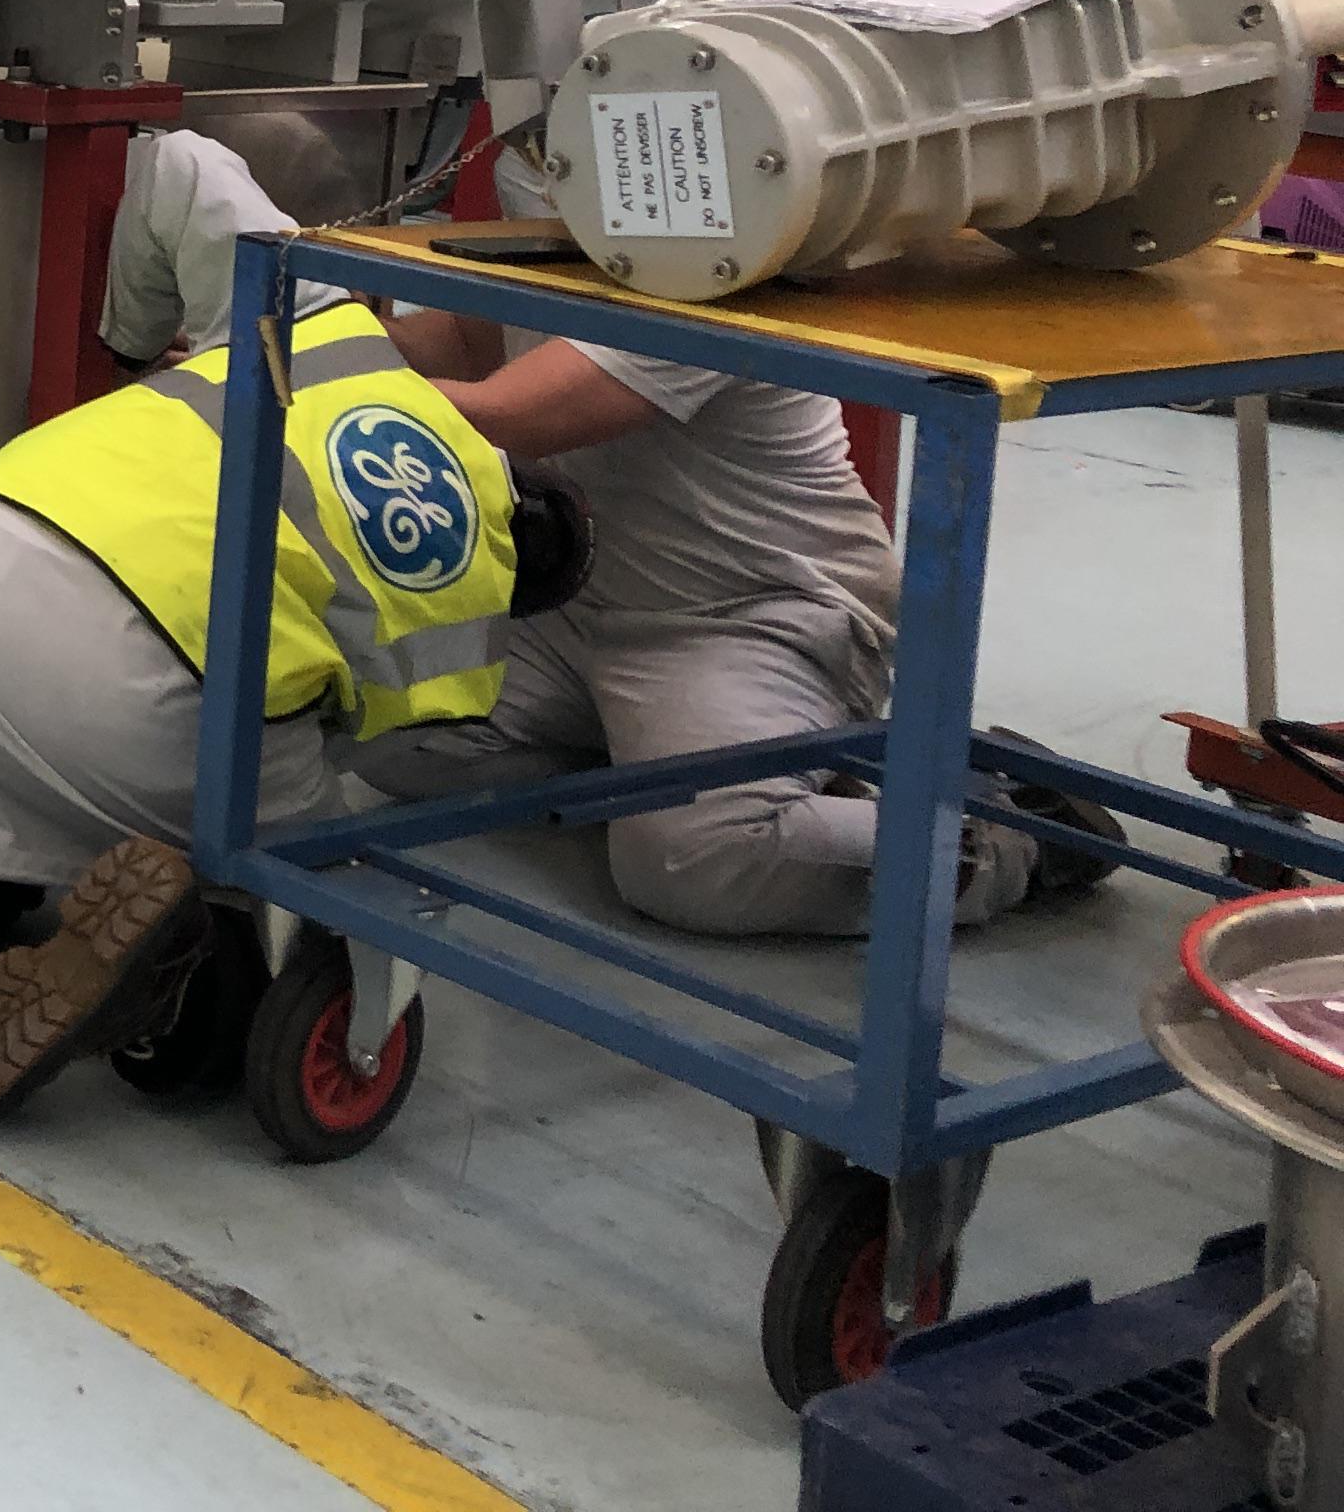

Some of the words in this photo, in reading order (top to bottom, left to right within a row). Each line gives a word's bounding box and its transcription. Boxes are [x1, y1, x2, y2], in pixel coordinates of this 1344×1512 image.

[636, 112, 653, 166] DEVISSER
[691, 103, 709, 165] UNSCREW
[612, 118, 634, 212] ATTENTION
[643, 173, 655, 196] PAS
[668, 127, 690, 203] CAUTION
[698, 173, 712, 200] NOT
[703, 208, 716, 227] DO
